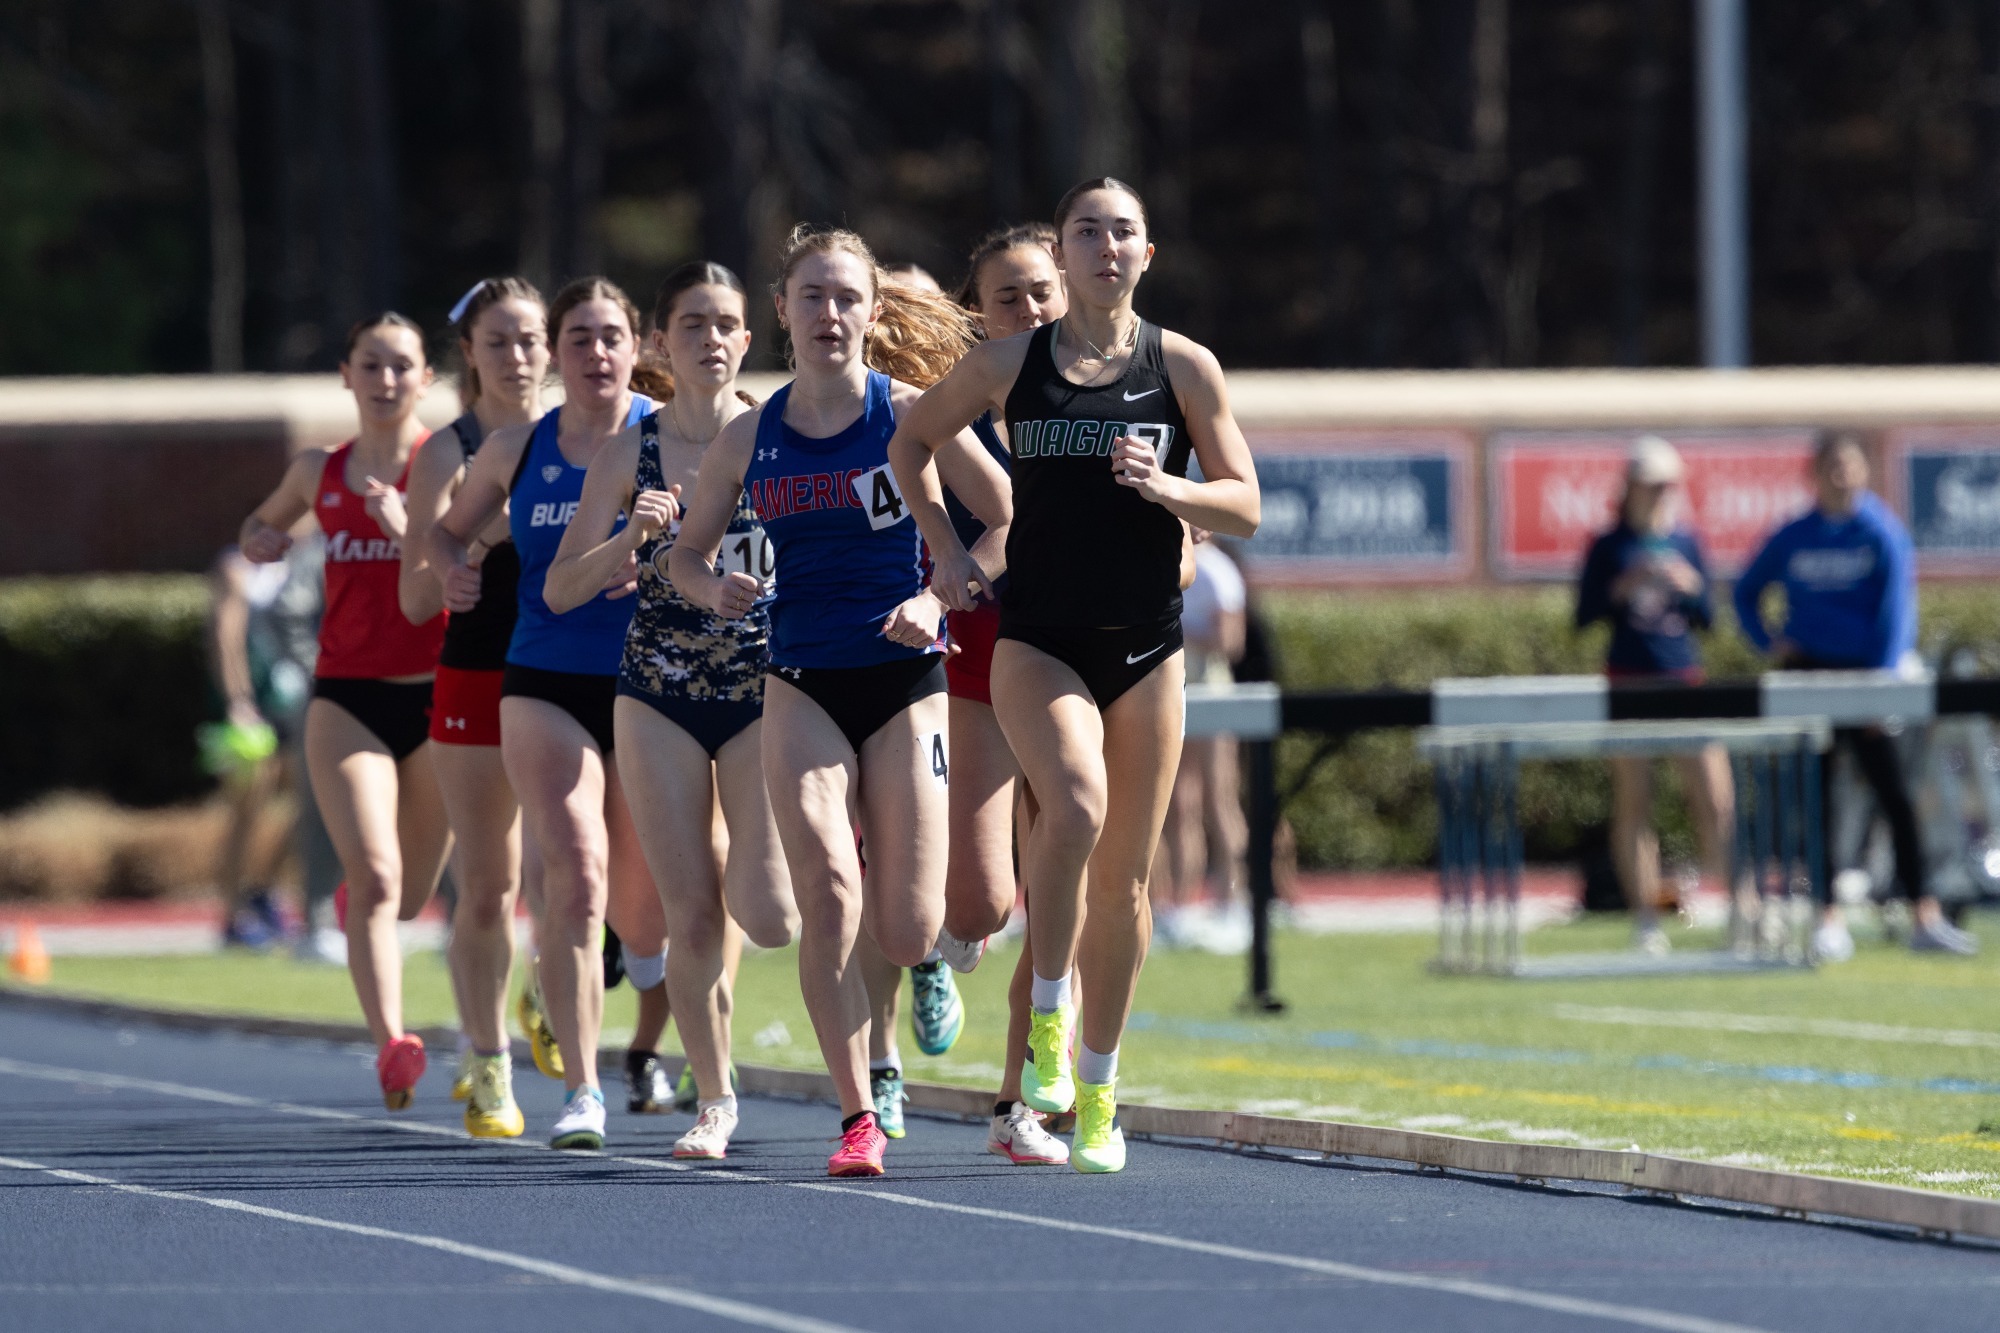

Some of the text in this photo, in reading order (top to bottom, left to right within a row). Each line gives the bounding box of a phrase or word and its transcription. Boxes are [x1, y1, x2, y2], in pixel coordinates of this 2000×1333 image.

[1014, 420, 1175, 458] WAGN
[1138, 428, 1162, 456] 7
[529, 501, 582, 527] BUF
[752, 466, 880, 524] AMERIC
[871, 469, 903, 521] 4
[733, 536, 775, 578] 10
[932, 733, 948, 785] 4
